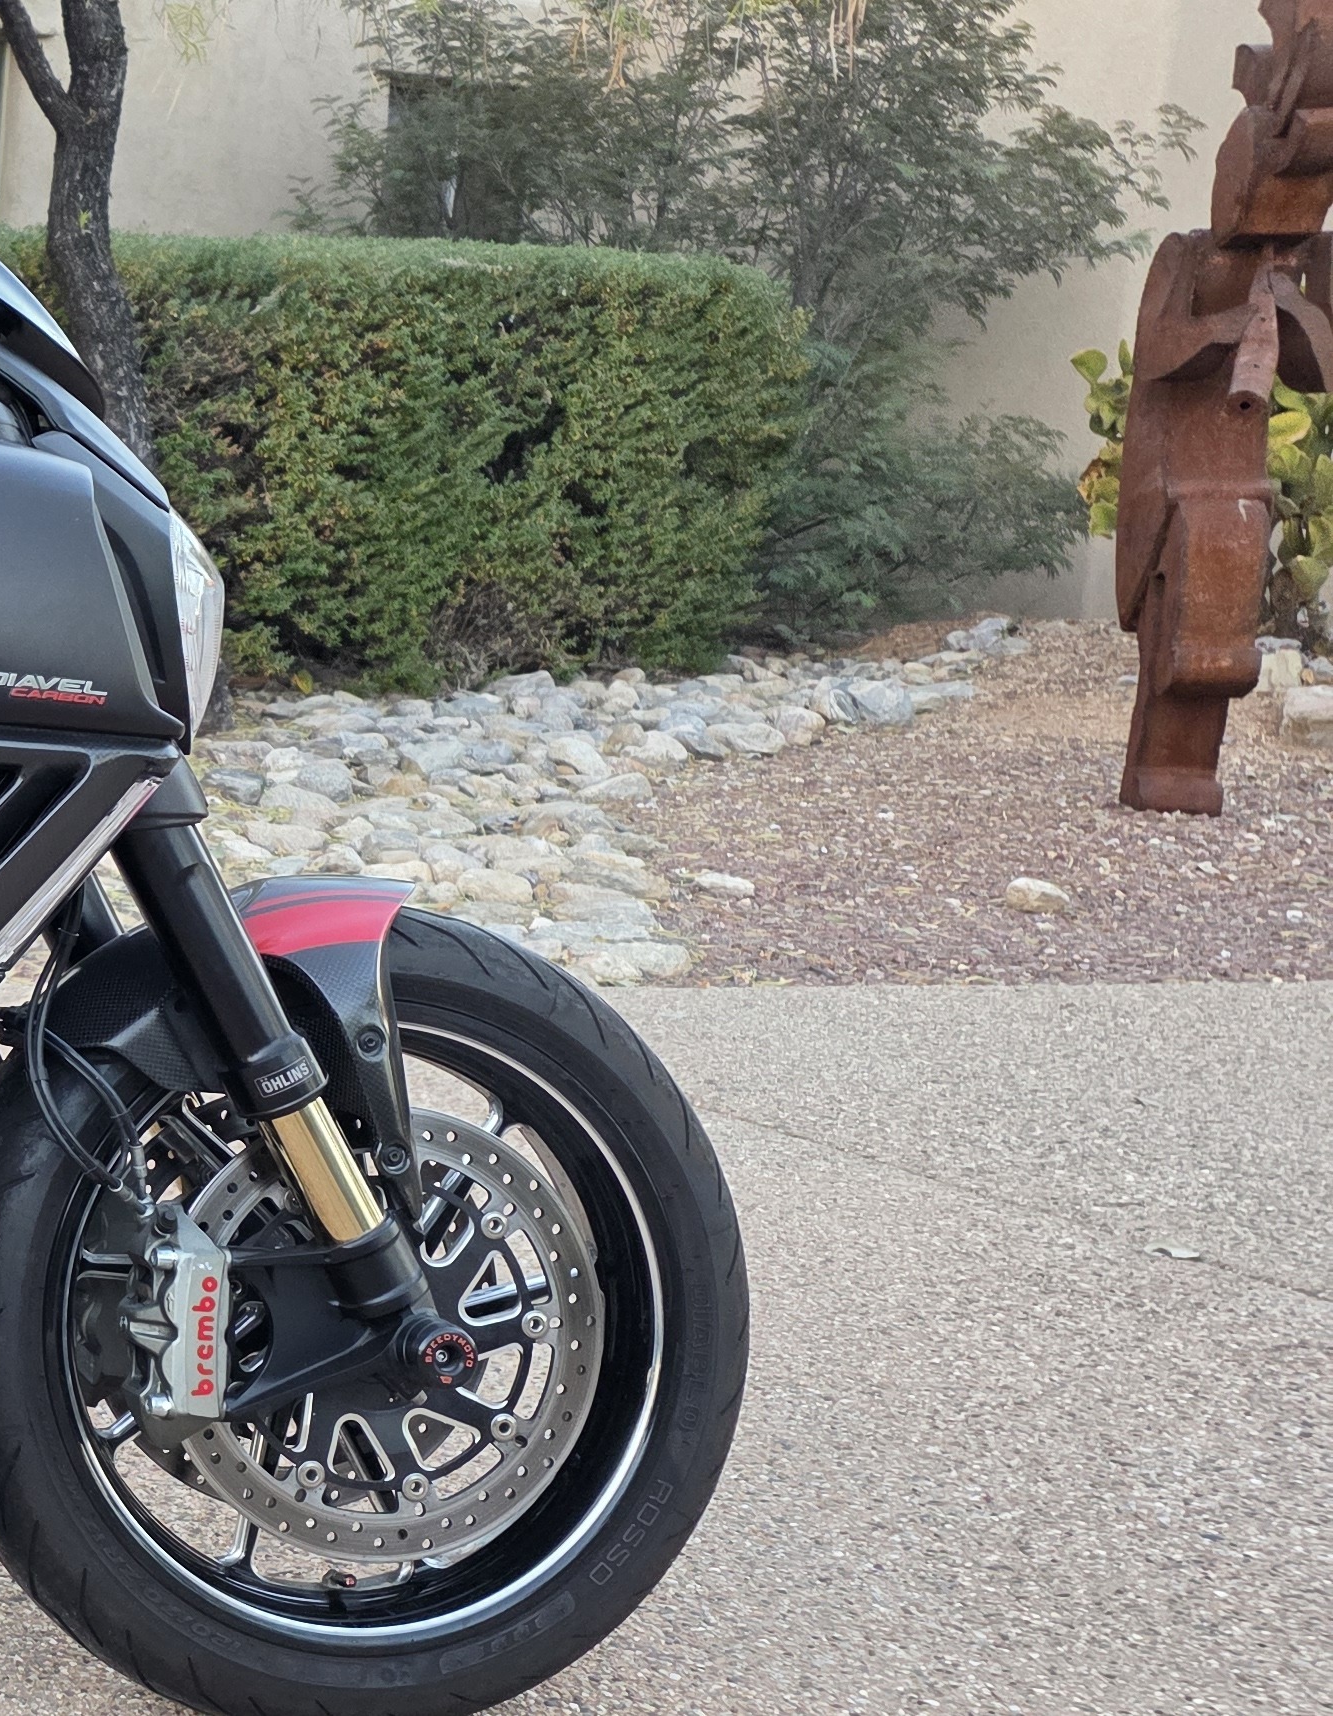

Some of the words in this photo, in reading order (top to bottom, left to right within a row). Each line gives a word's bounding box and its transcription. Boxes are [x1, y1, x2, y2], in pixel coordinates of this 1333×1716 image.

[9, 687, 106, 705] CARBON
[260, 1061, 310, 1094] ÖHLINS
[589, 1478, 673, 1587] ROSSO
